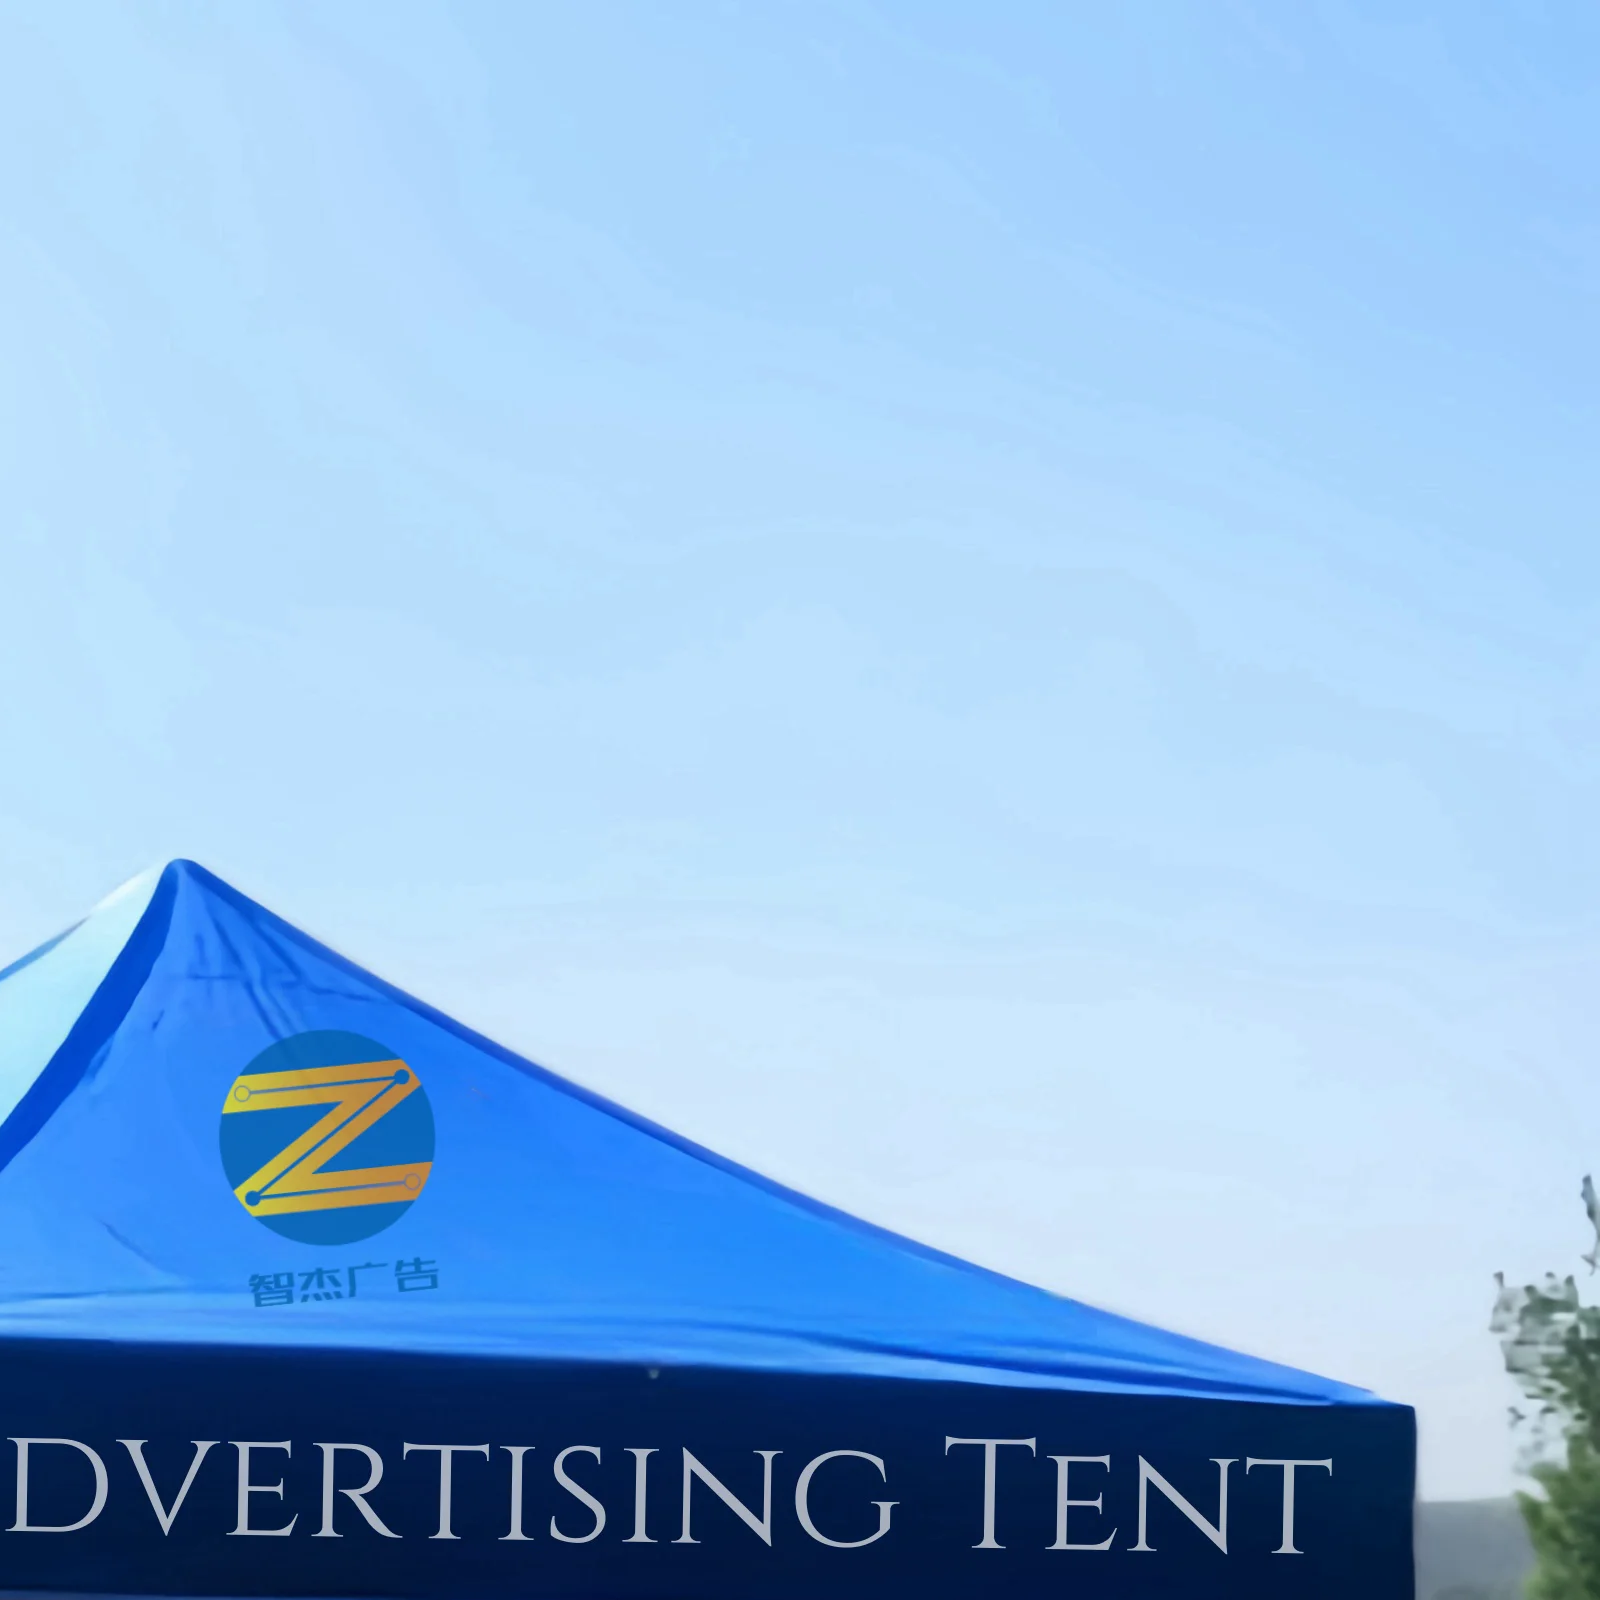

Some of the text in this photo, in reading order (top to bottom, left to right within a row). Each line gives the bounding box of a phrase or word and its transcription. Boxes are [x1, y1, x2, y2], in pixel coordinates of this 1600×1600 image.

[248, 1256, 440, 1308] 智杰广告
[945, 1435, 1333, 1555] TENT
